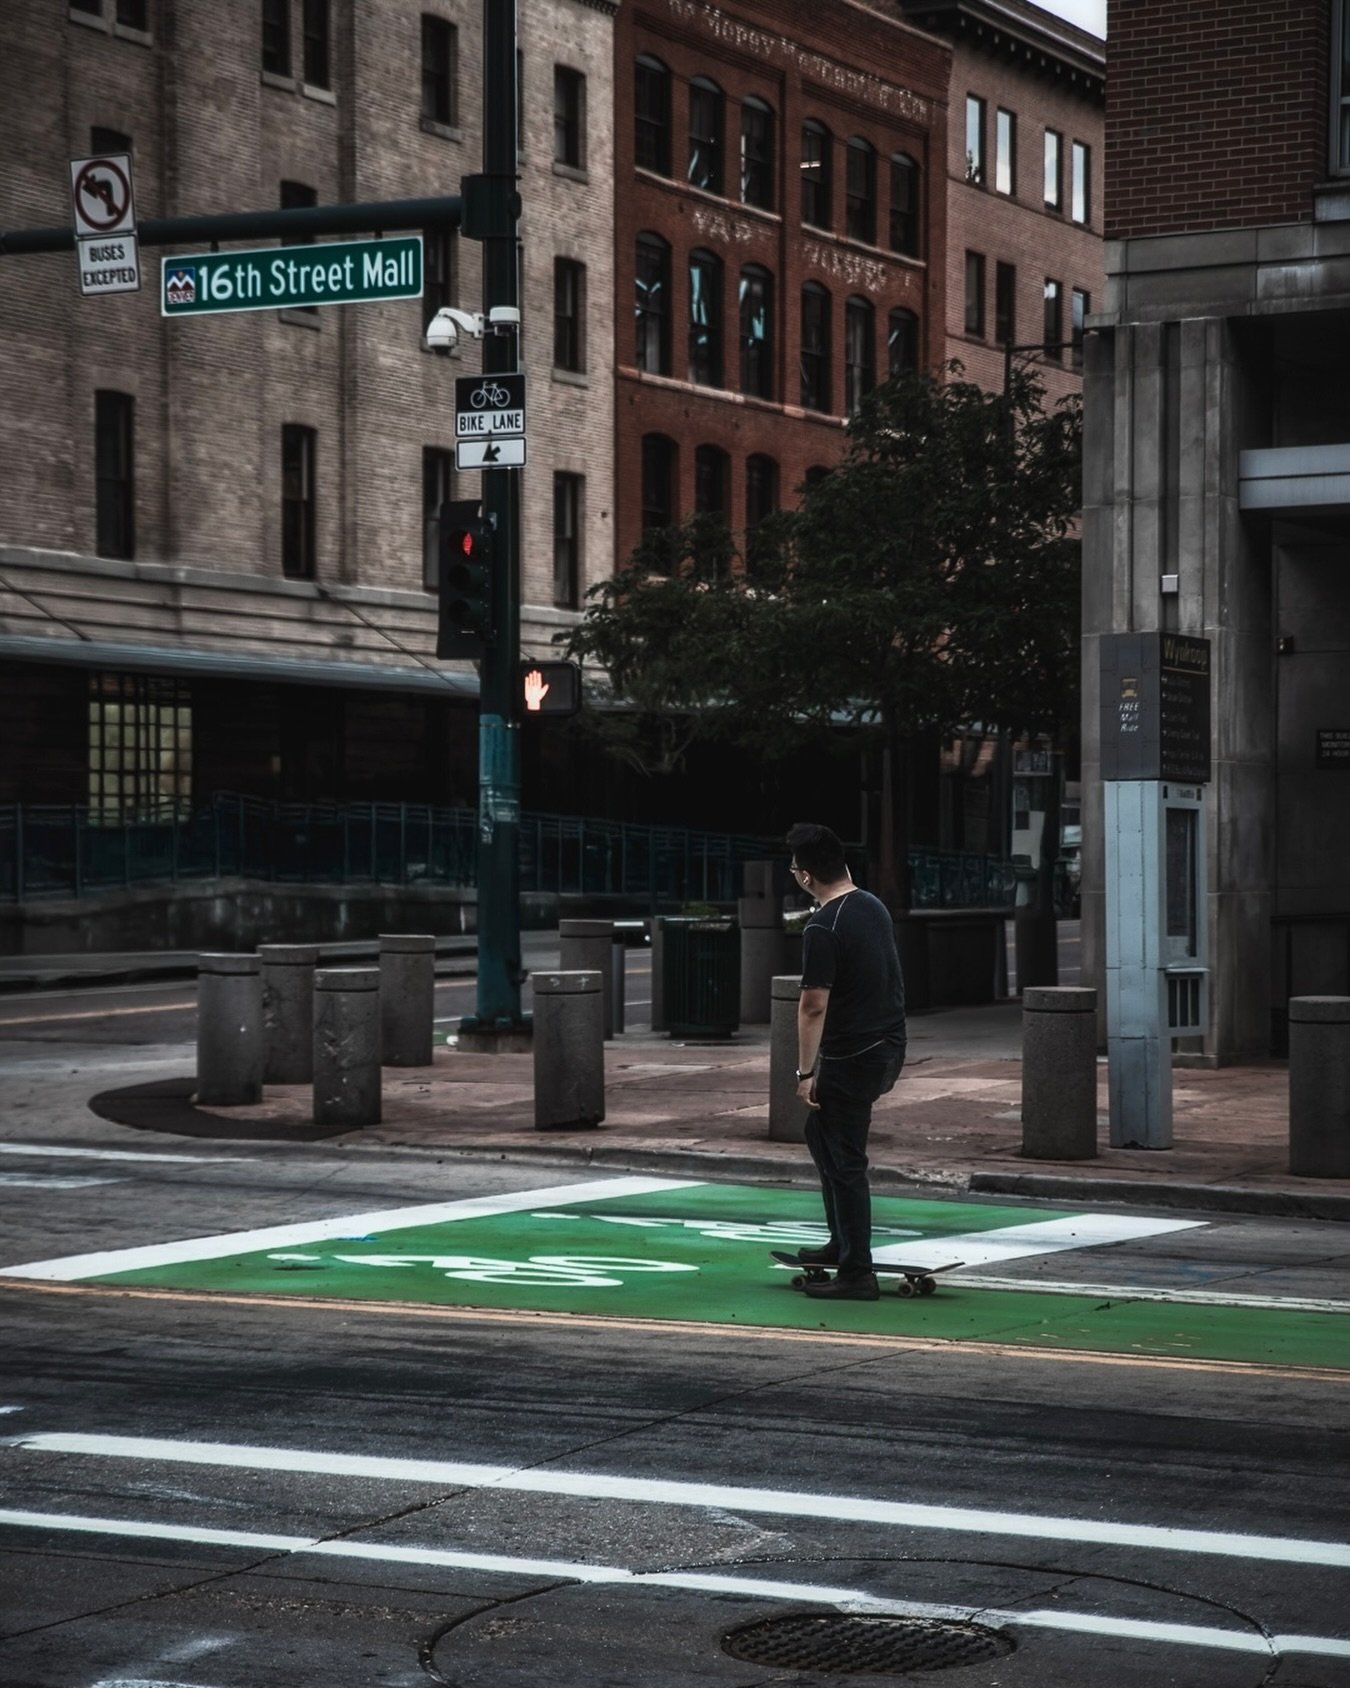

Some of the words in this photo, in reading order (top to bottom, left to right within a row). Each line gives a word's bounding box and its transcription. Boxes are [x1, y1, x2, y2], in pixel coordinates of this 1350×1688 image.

[89, 243, 125, 262] BUSES
[83, 266, 136, 287] EXCEPTED
[199, 263, 261, 301] 16th
[270, 254, 354, 296] Street
[362, 249, 414, 289] Mall
[459, 415, 484, 431] BIKE
[493, 413, 521, 430] LANE
[1119, 702, 1140, 711] FREE
